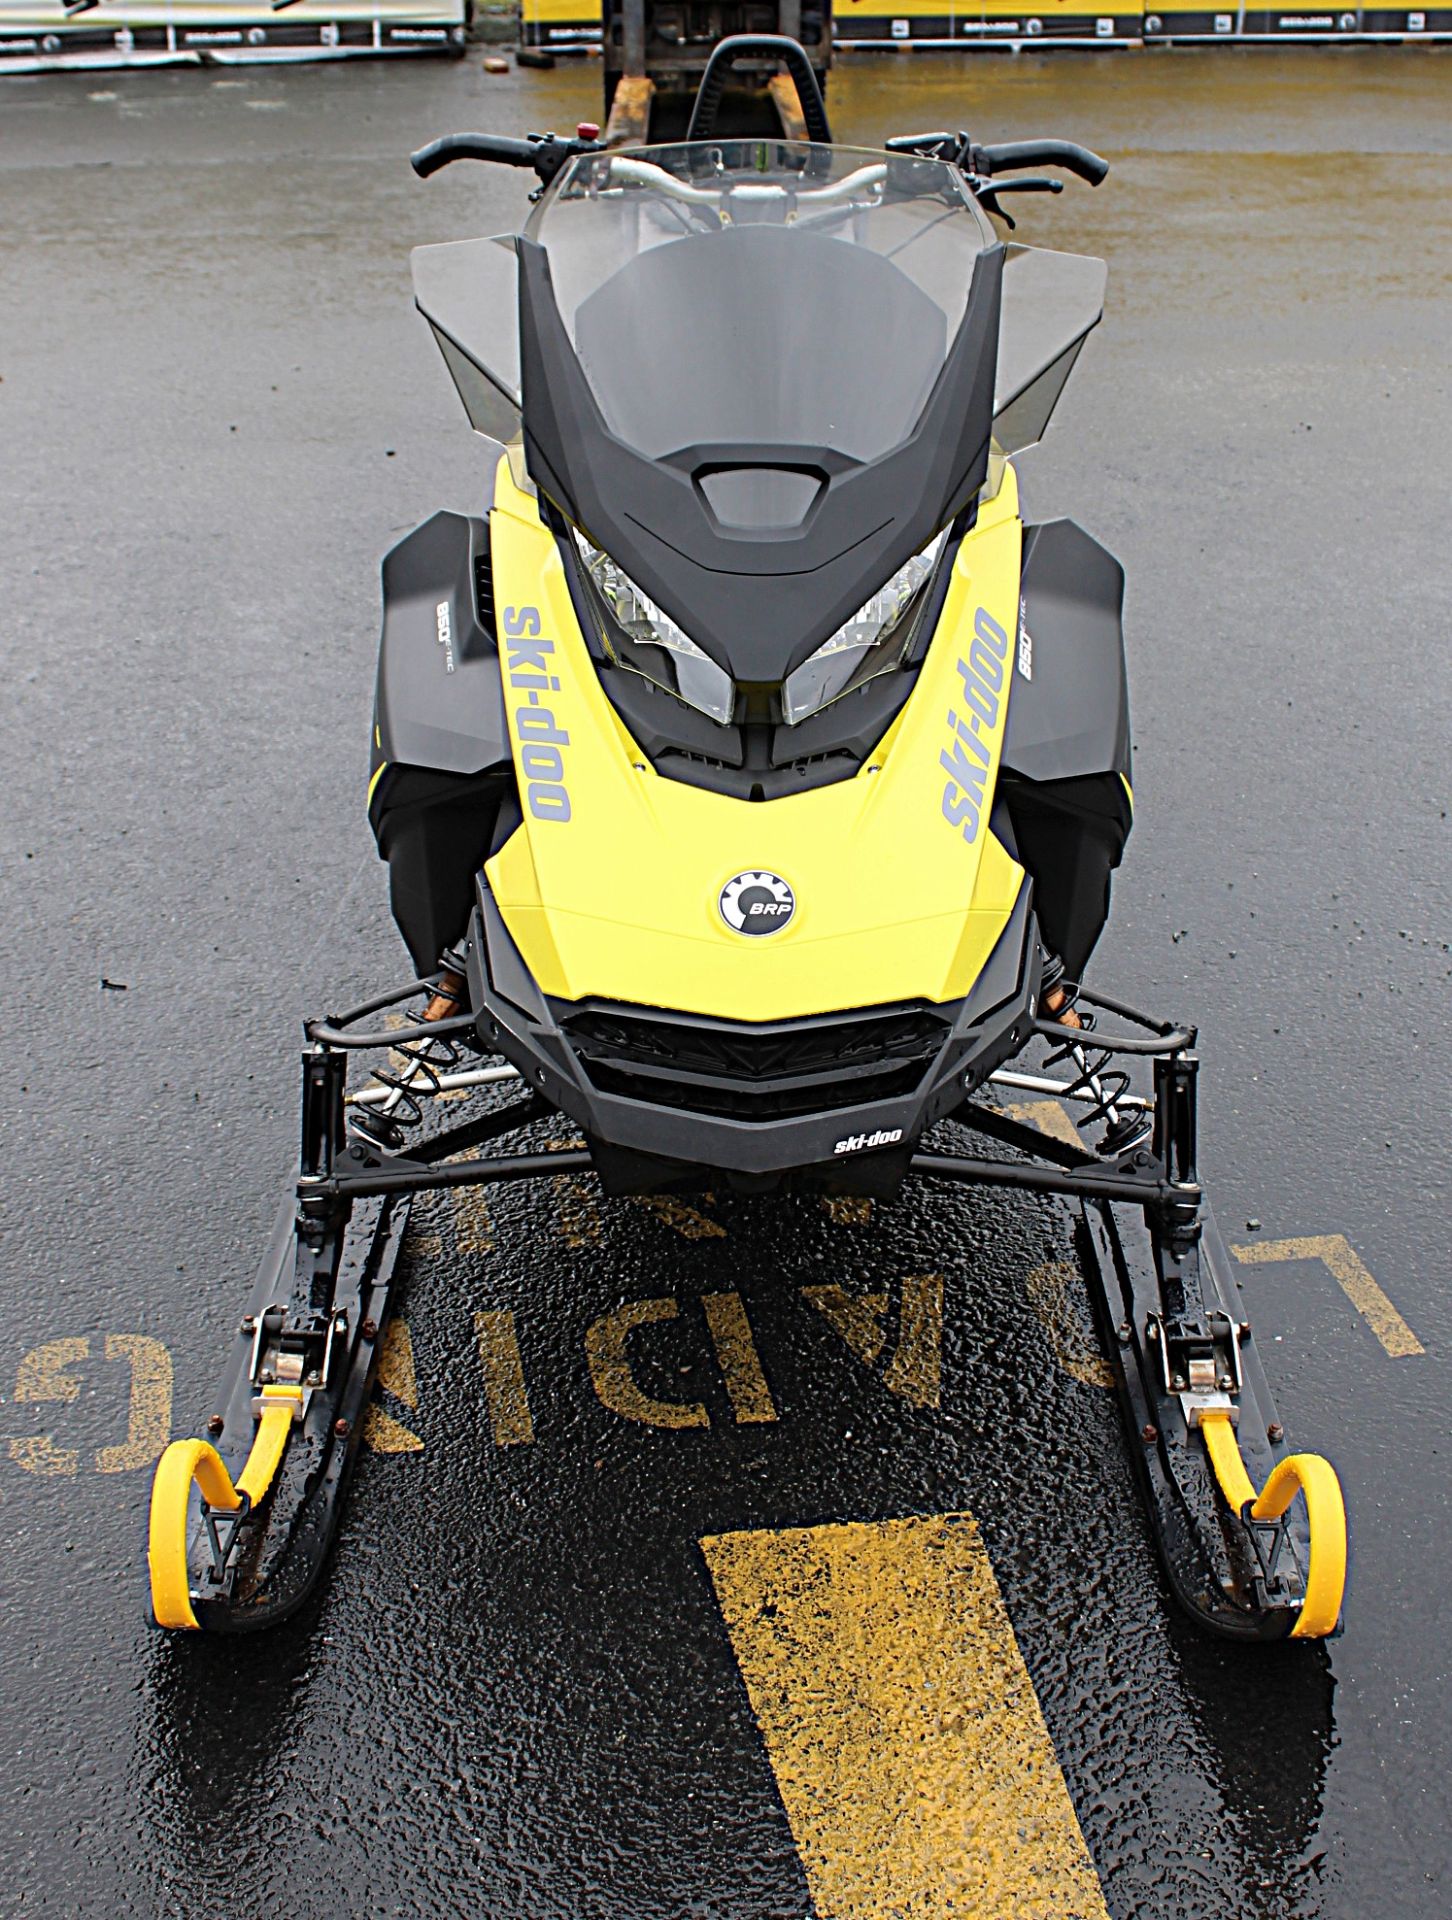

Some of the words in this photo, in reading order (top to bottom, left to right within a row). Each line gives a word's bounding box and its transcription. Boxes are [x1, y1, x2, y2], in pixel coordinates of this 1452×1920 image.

[436, 601, 451, 643] 850
[1018, 630, 1033, 681] 850
[503, 606, 571, 823] ski-doo
[939, 606, 1008, 844] ski-doo
[749, 903, 792, 915] BRP
[833, 1129, 903, 1154] ski-doo
